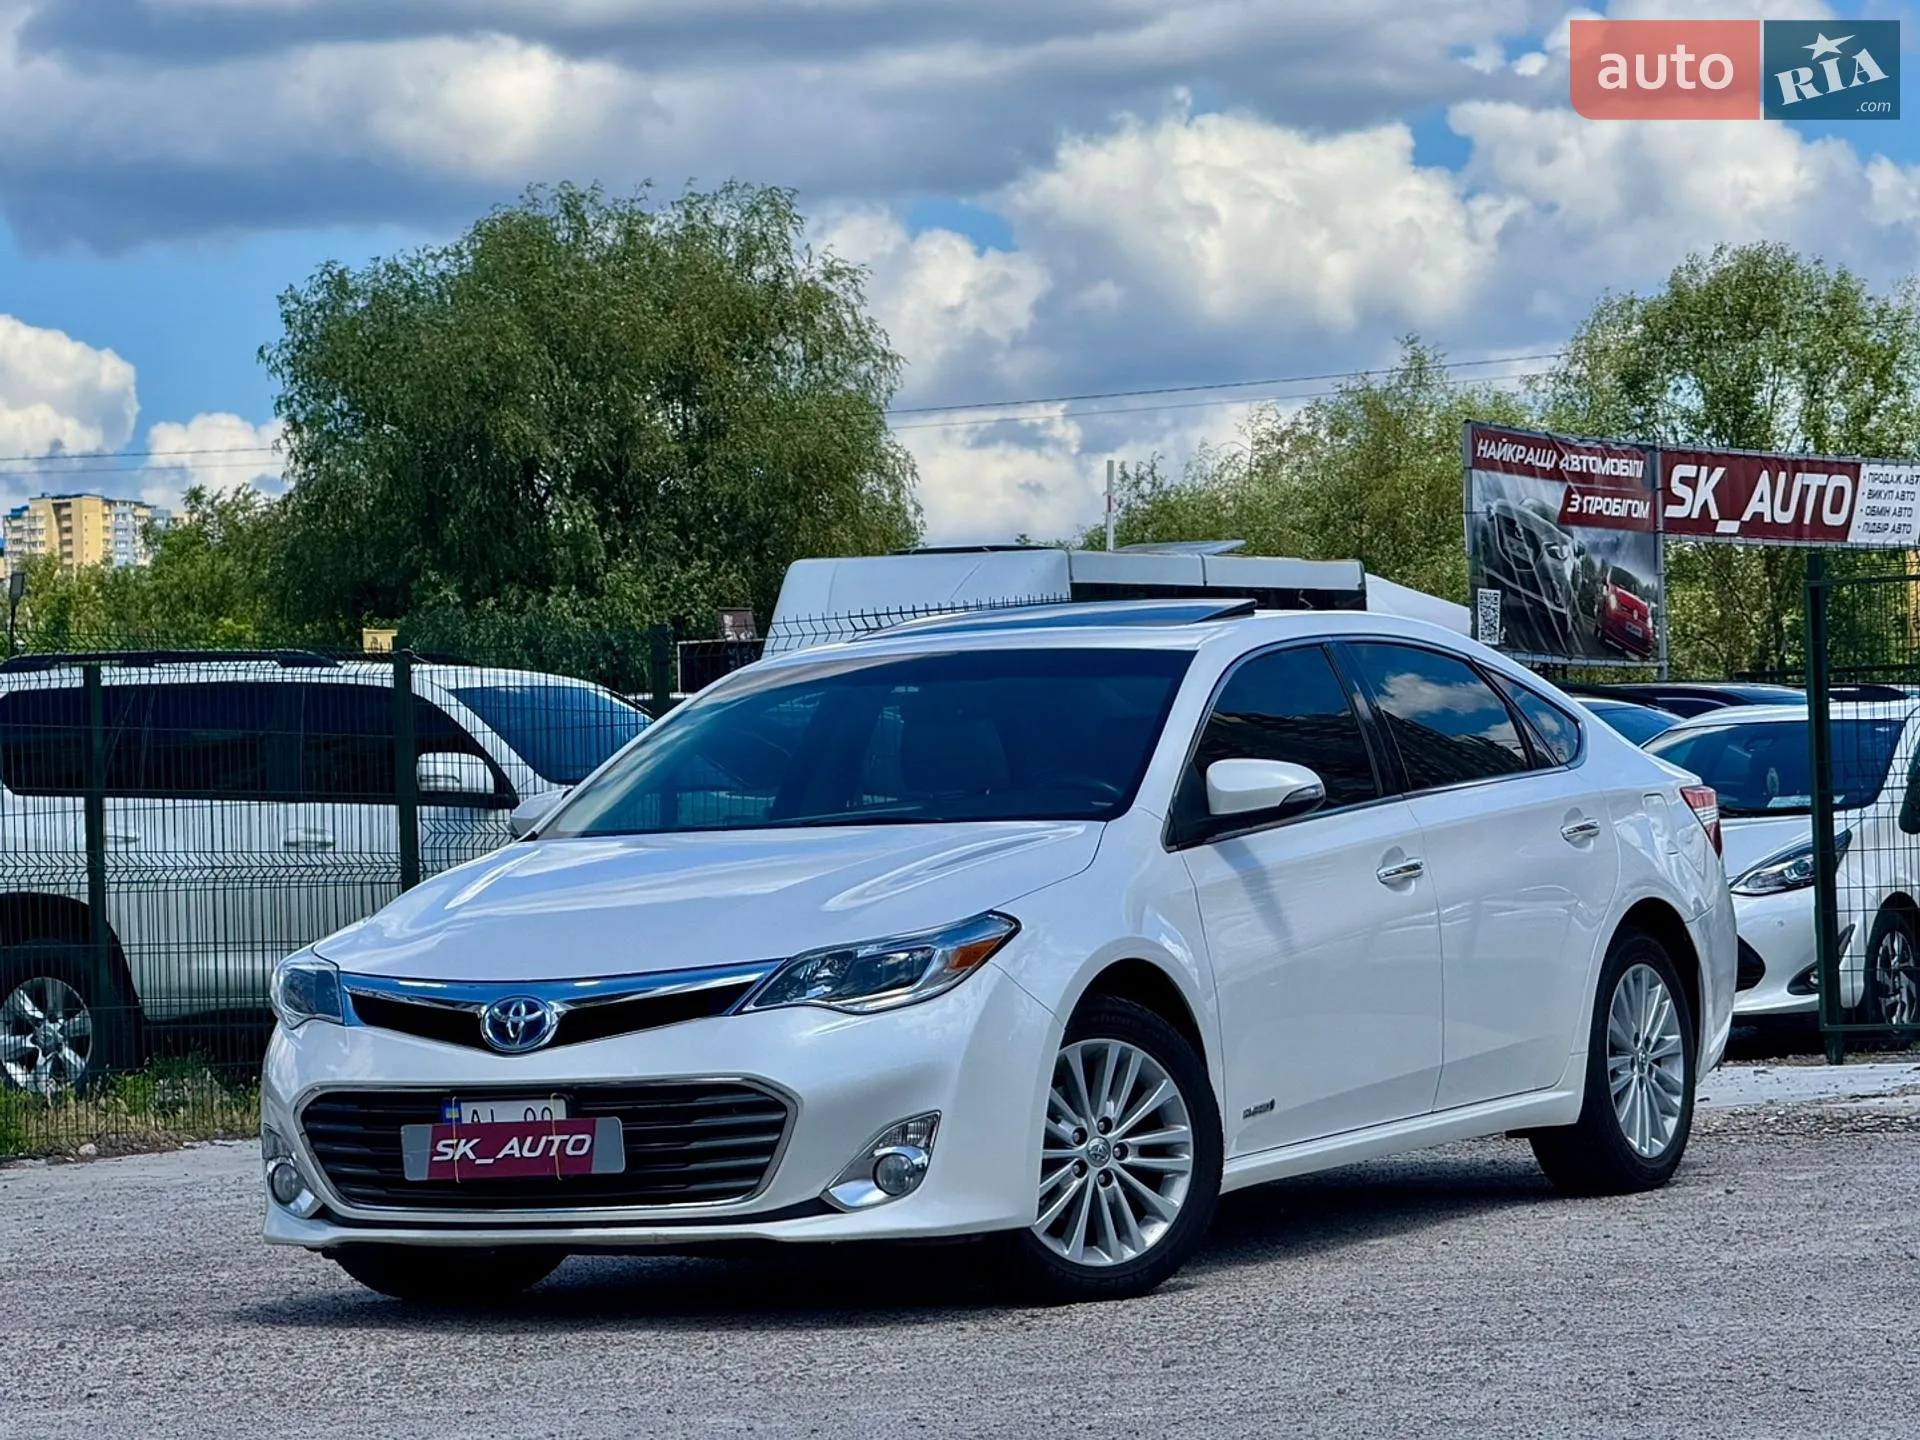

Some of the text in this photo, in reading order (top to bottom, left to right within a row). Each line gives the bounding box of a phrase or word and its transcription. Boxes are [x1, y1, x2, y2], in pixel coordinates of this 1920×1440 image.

[1476, 437, 1645, 478] НАЙКРАЩІ АВТОМОБІЛІ
[1582, 494, 1650, 519] ПРОБІГОМ
[1663, 463, 1853, 534] SK_AUTO
[1867, 489, 1916, 502] ВИКУП АВТО
[1891, 507, 1913, 518] АВТО
[1890, 523, 1912, 535] АВТО
[431, 1133, 592, 1165] SK_AUTO
